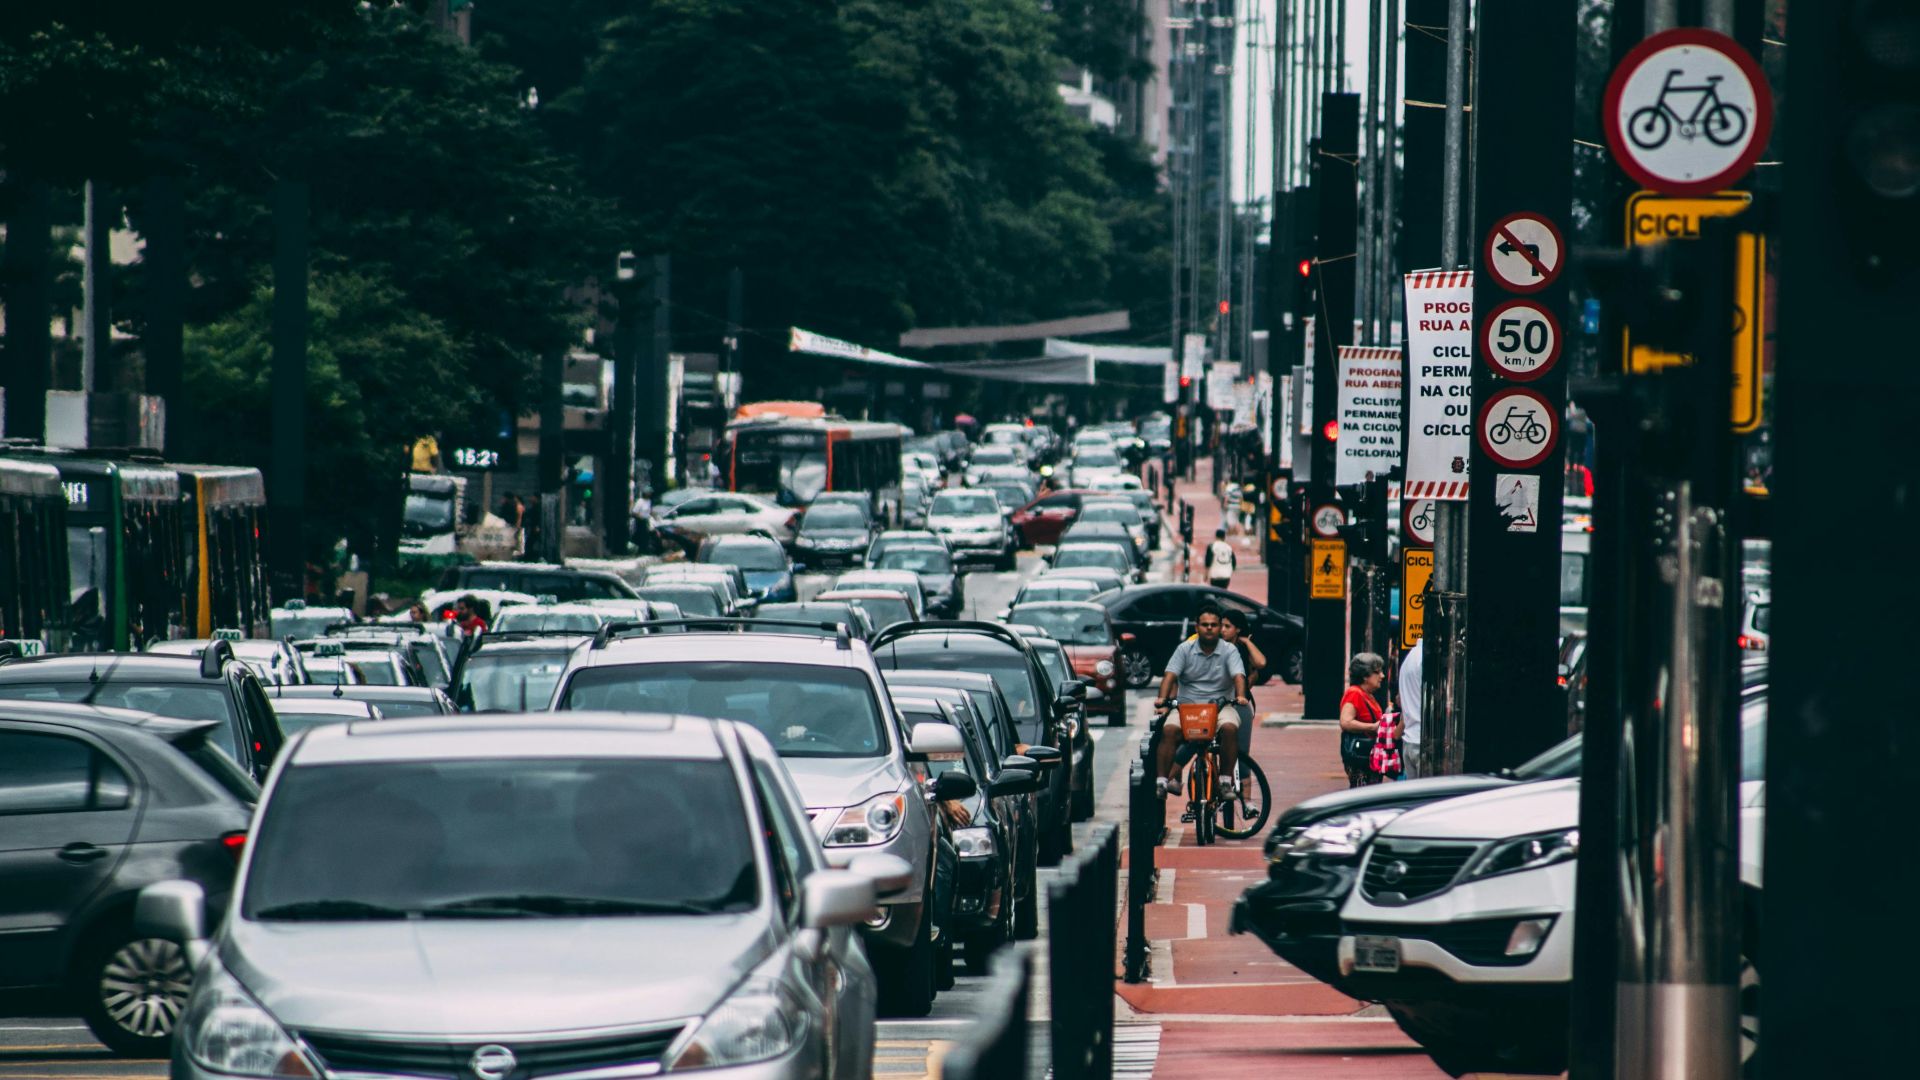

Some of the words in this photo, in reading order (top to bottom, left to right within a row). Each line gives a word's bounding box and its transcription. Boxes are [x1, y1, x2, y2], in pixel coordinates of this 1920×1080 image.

[1420, 320, 1454, 331] RUA
[1497, 319, 1548, 354] 50
[1433, 346, 1470, 358] CICL
[1504, 356, 1535, 367] km/h
[1345, 380, 1368, 388] RUA
[1420, 385, 1443, 397] NA
[1444, 405, 1468, 416] OU
[1343, 423, 1359, 431] NA
[1360, 436, 1376, 444] OU
[1380, 436, 1394, 445] NA
[1407, 556, 1433, 566] CICL
[217, 631, 240, 640] TAXI
[19, 642, 39, 656] XI
[320, 644, 340, 653] TAXI
